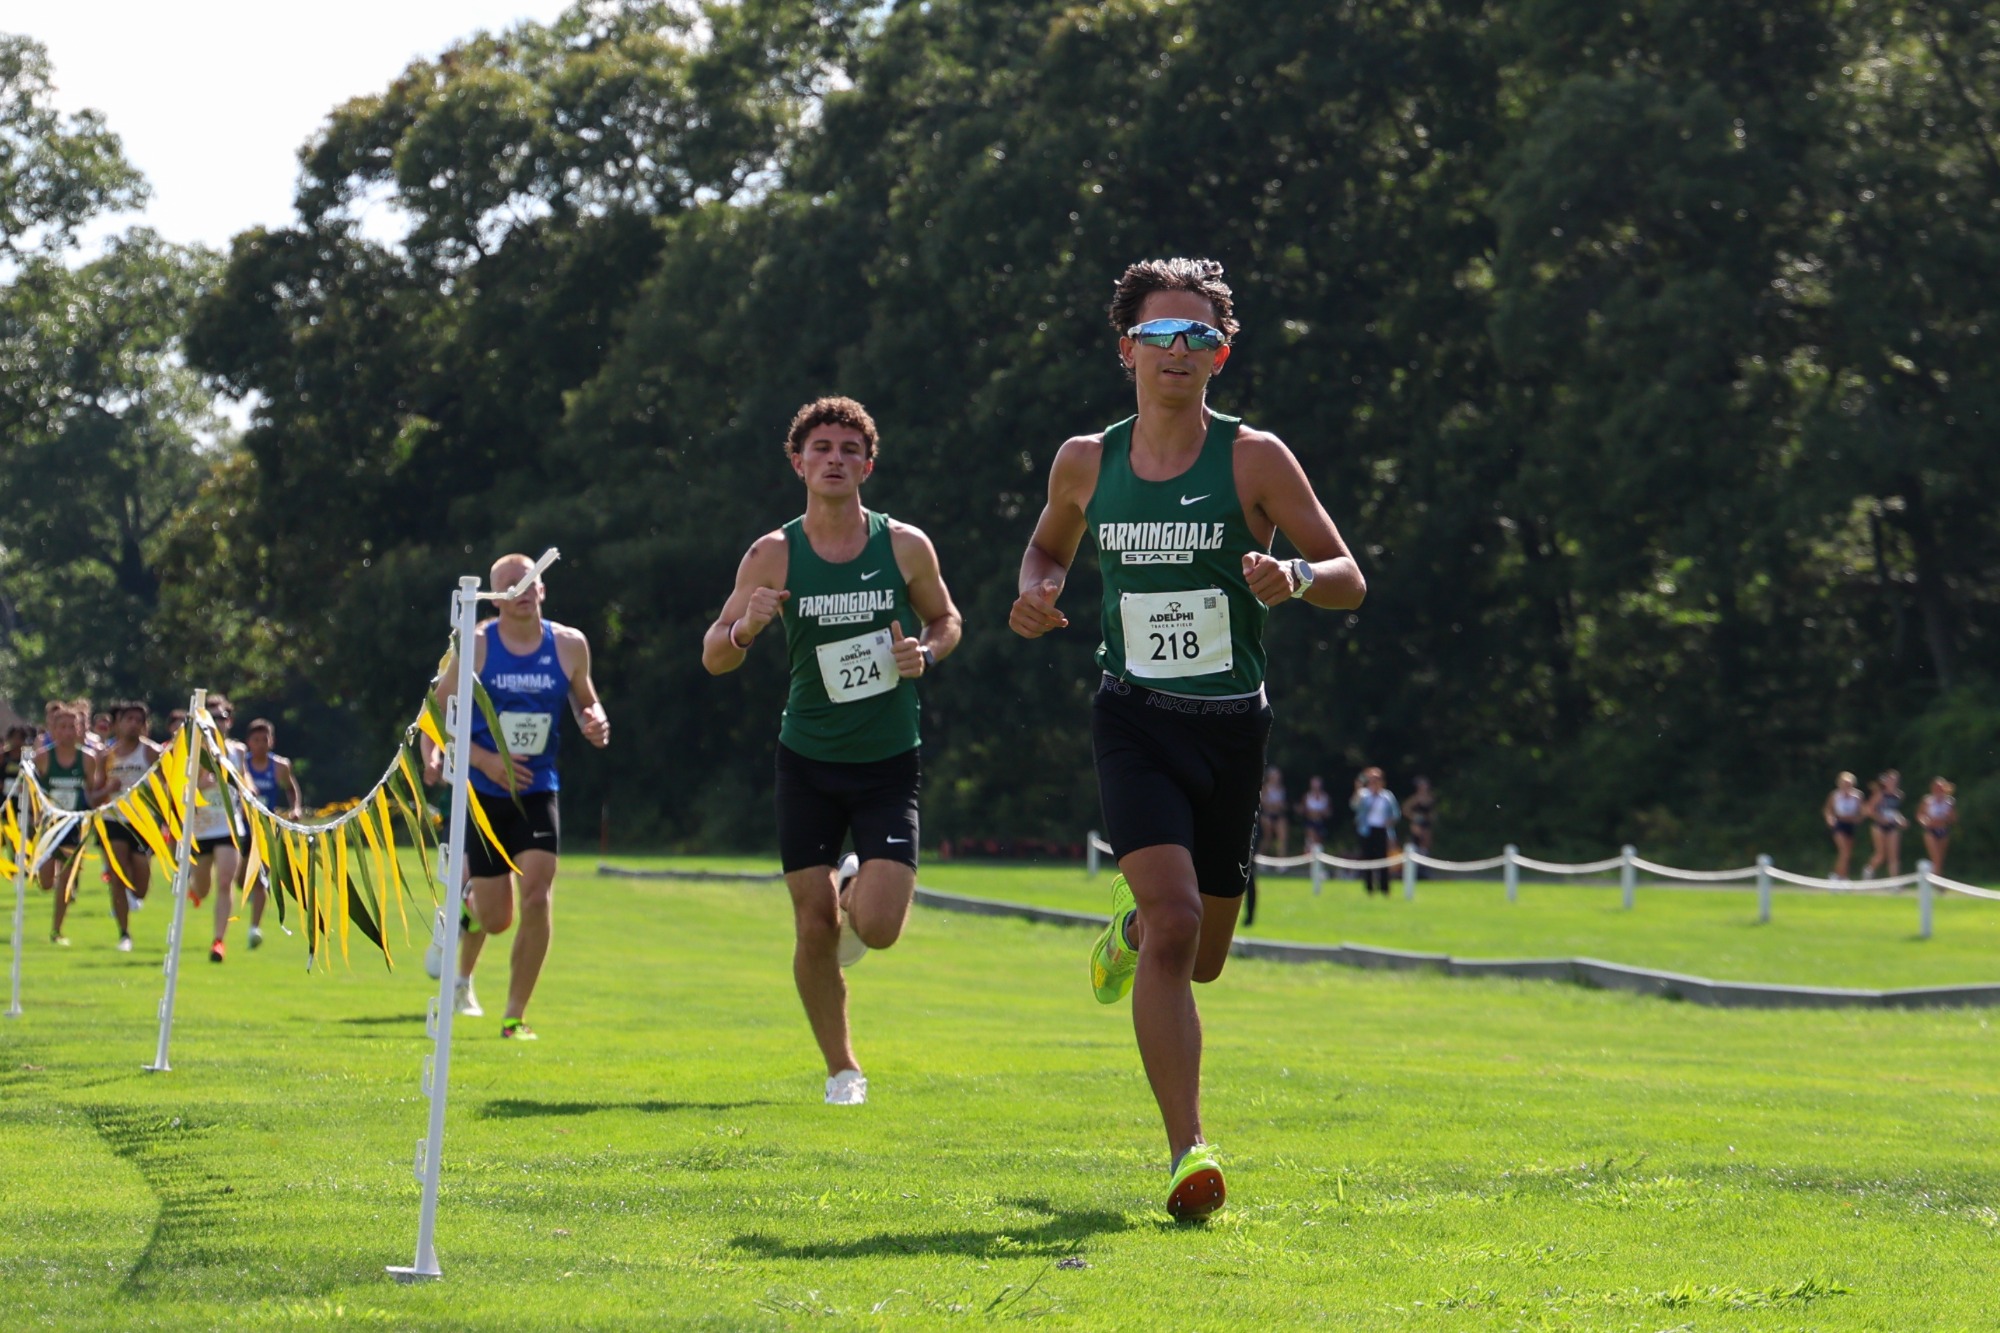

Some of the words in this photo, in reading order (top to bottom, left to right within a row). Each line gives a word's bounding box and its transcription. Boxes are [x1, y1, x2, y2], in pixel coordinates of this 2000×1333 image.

[1099, 522, 1224, 550] FARMINGDALE
[1125, 553, 1189, 561] STATE
[799, 589, 894, 618] FARMINGDALE
[821, 613, 870, 623] STATE
[1149, 612, 1194, 622] ADELPHI
[1149, 630, 1200, 660] 218
[840, 649, 871, 662] ADELPHI
[496, 673, 552, 689] USMMA
[839, 660, 881, 690] 224
[1146, 692, 1201, 714] NIKE
[1202, 700, 1250, 715] PRO
[511, 731, 538, 747] 357
